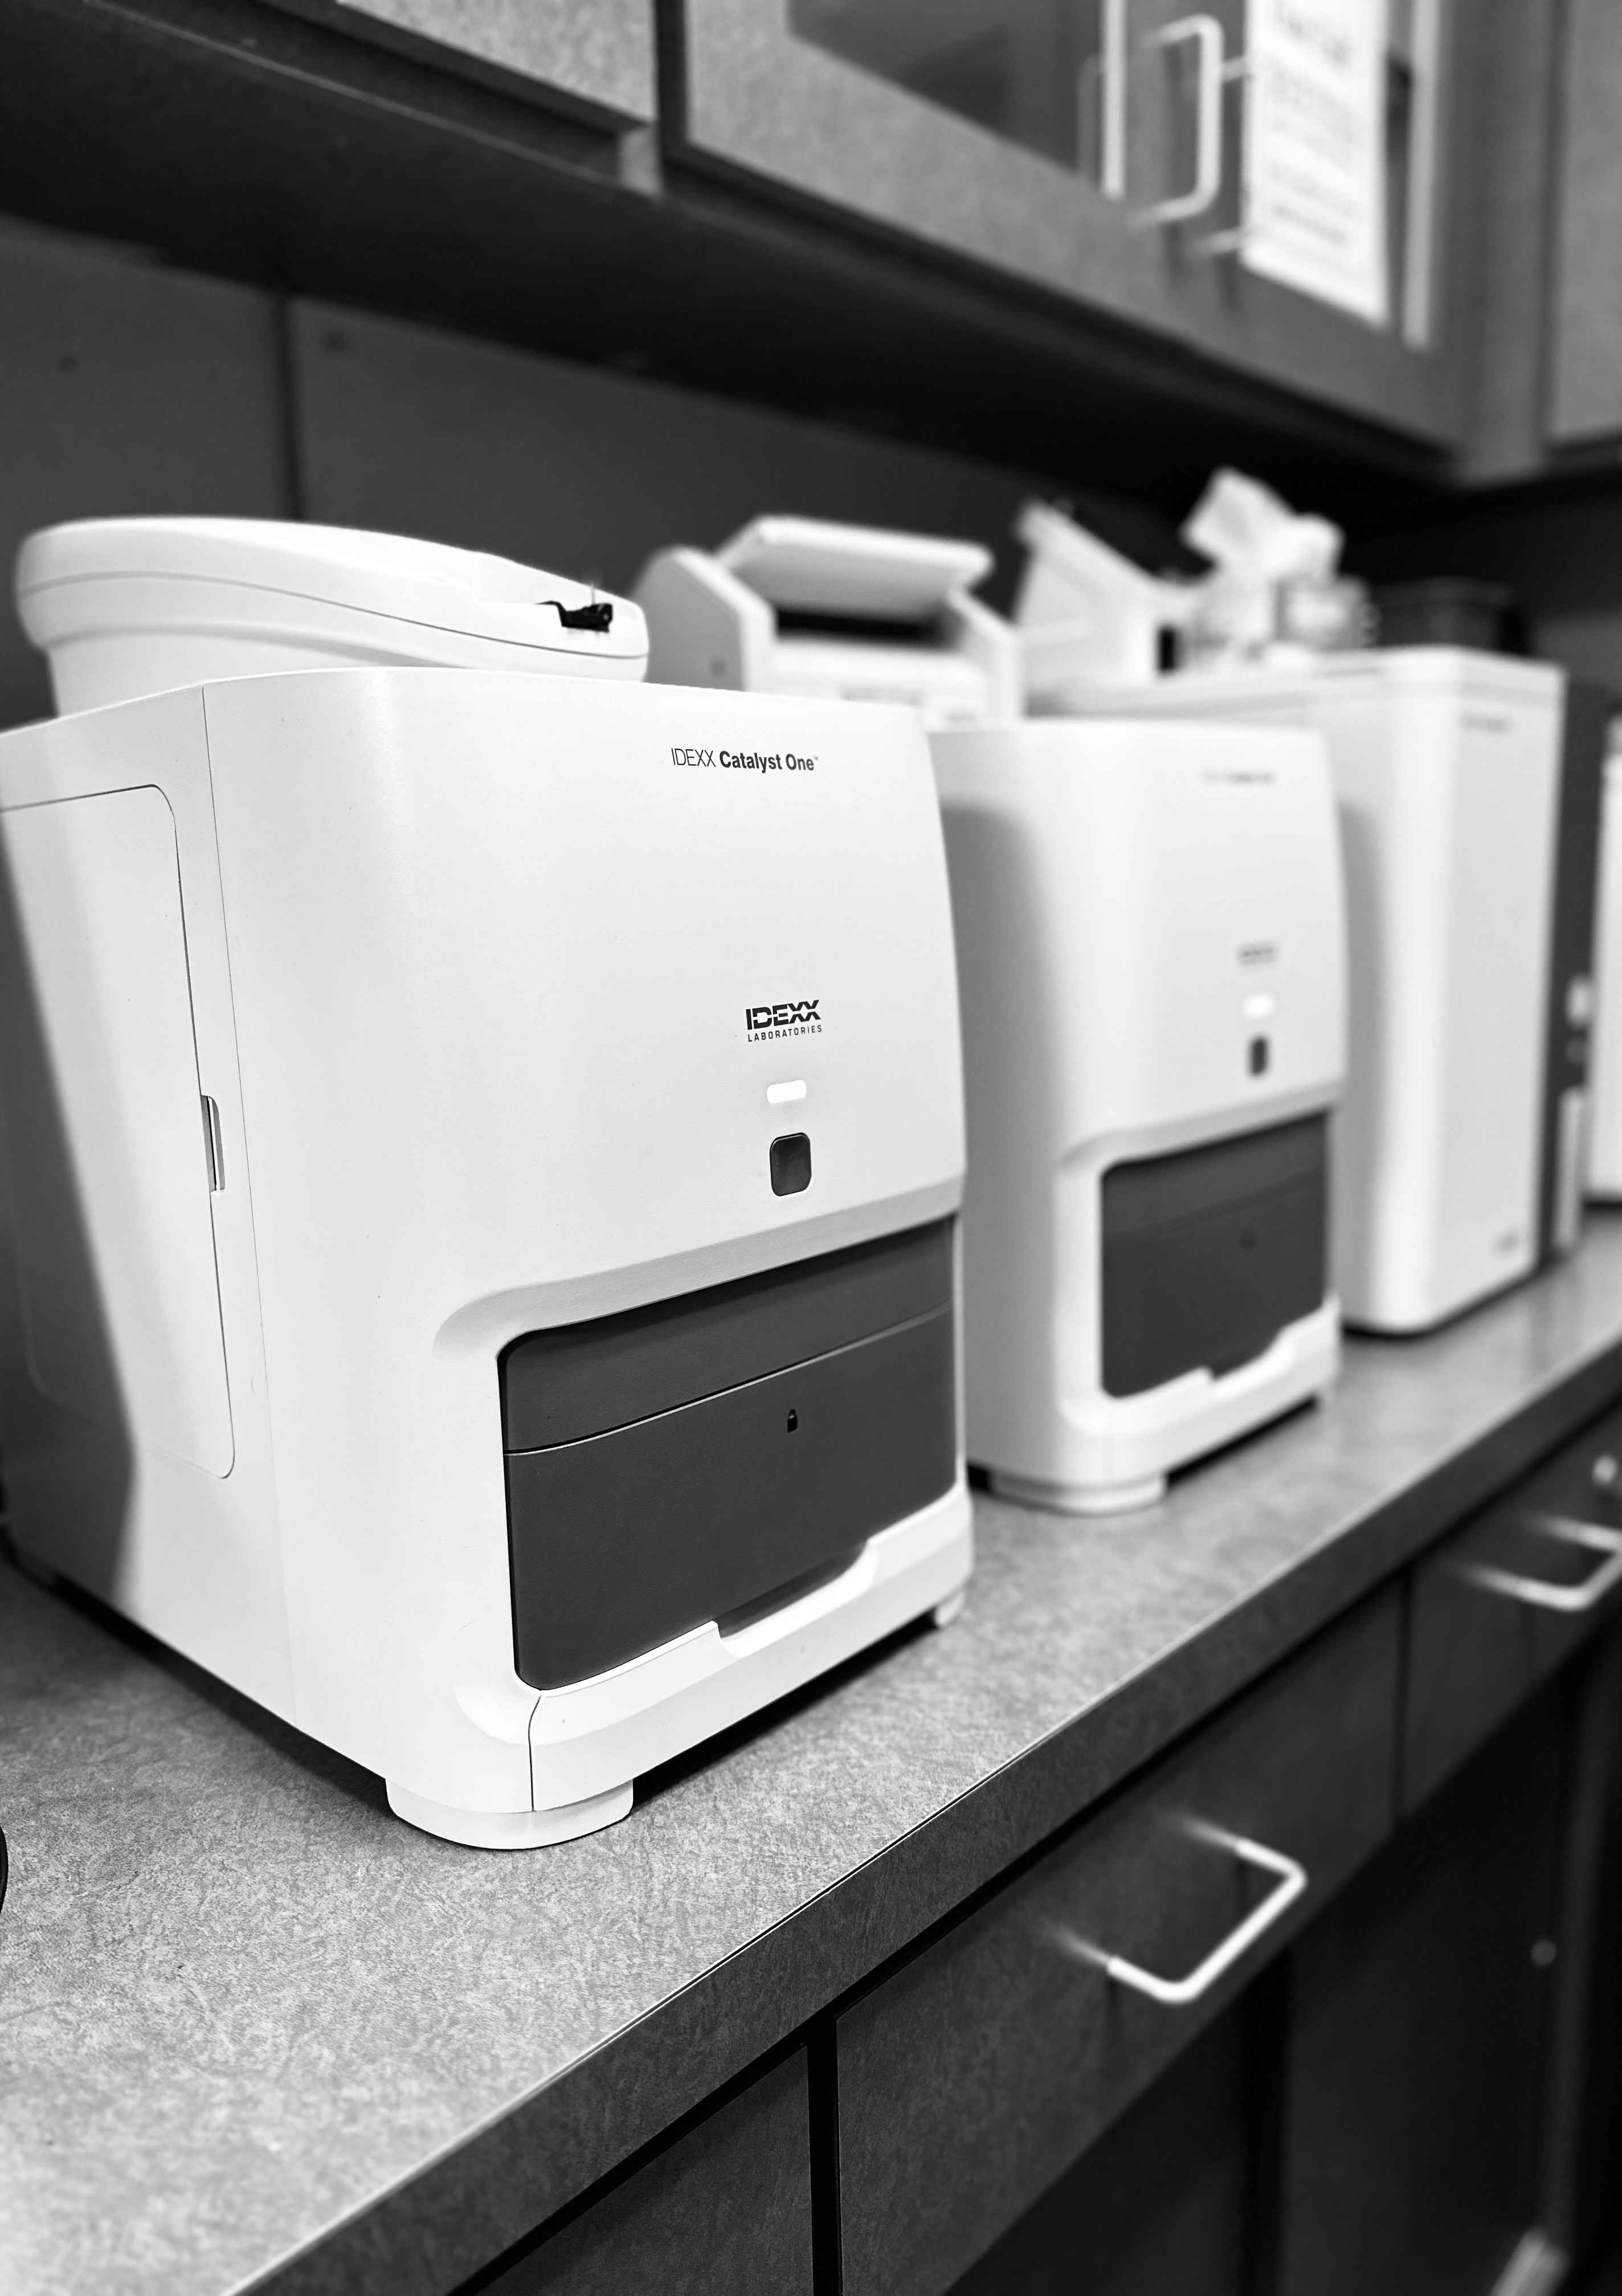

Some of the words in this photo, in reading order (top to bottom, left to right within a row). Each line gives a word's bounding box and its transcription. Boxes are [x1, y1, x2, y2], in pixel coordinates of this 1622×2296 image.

[671, 747, 716, 767] IDEXX
[719, 750, 783, 774] Catalyst
[745, 999, 822, 1030] IDEXX
[747, 1024, 822, 1042] LABORATORIES
